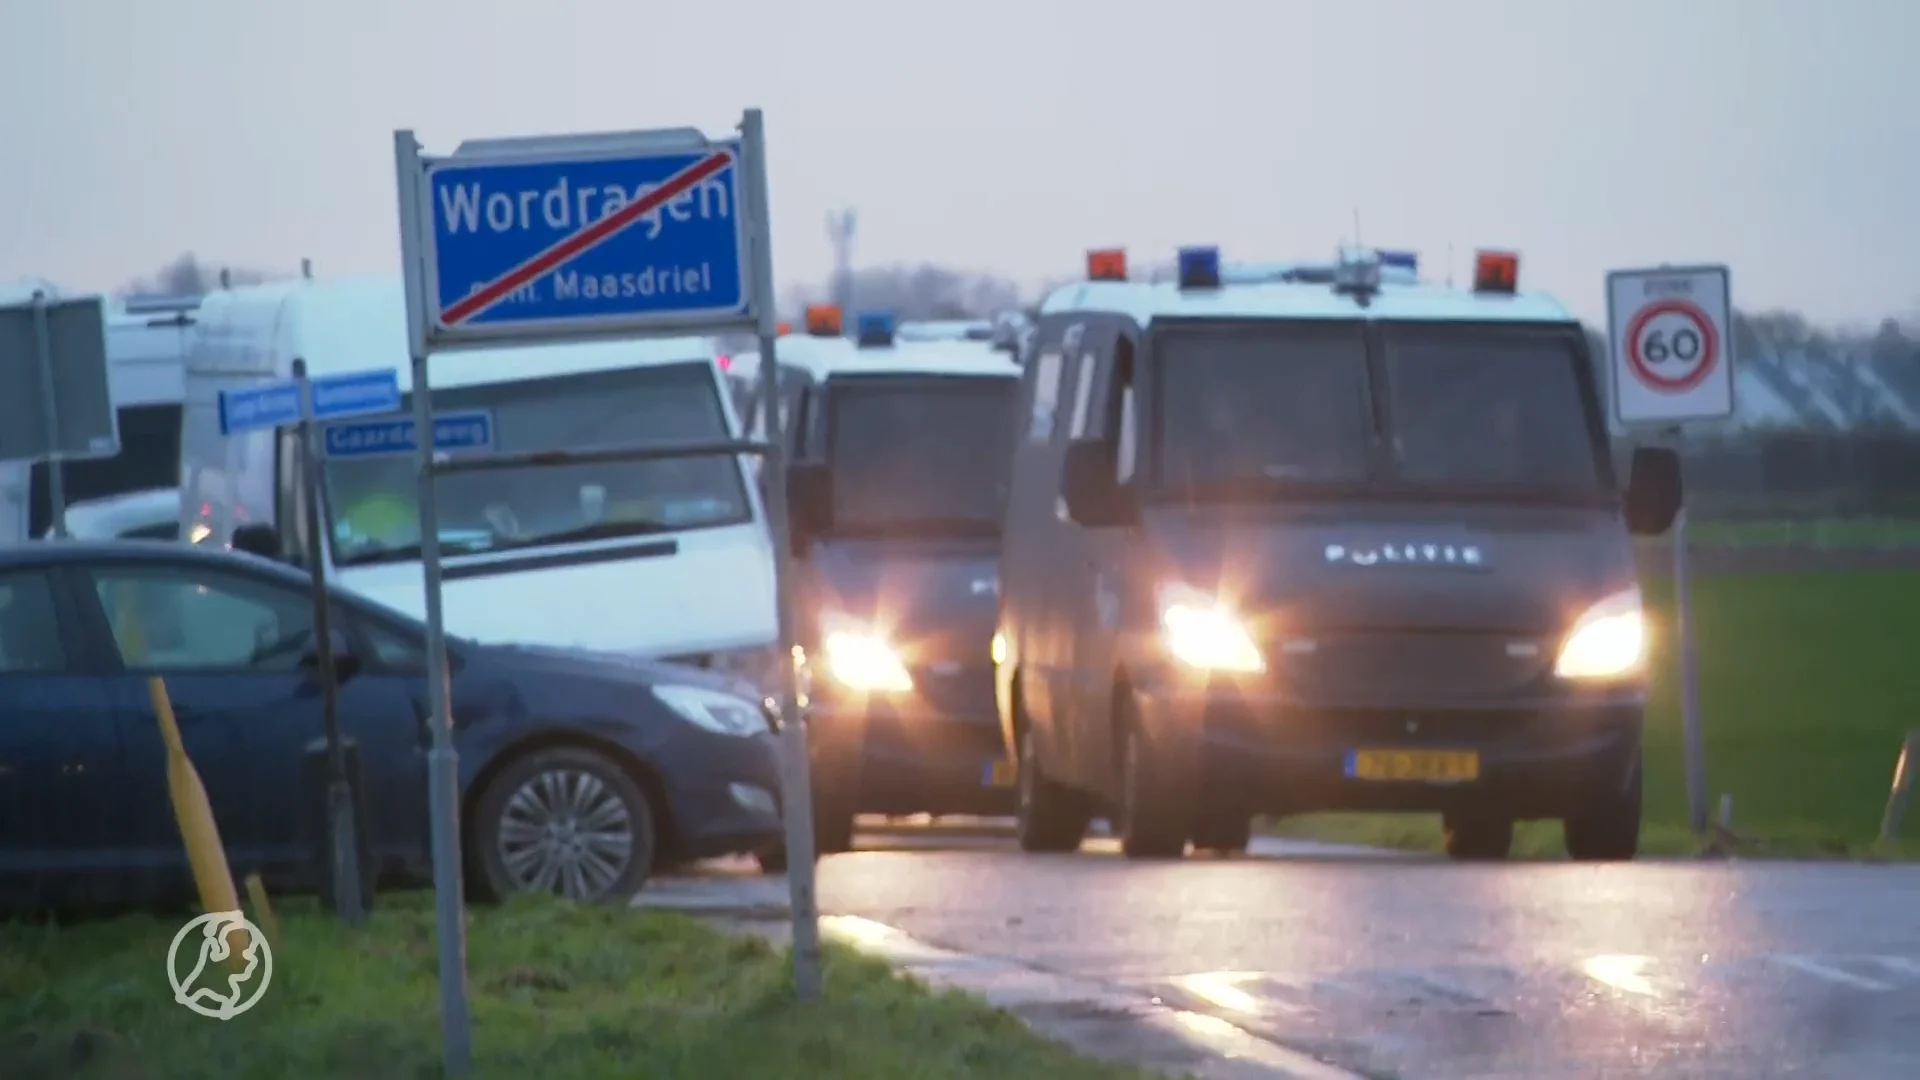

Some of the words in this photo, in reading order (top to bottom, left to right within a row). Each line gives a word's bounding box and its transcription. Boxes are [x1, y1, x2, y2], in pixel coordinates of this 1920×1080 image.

[440, 175, 728, 239] Wordragen
[554, 262, 710, 300] Maasdriel
[1644, 329, 1699, 364] 60
[1325, 543, 1481, 566] POLITIE
